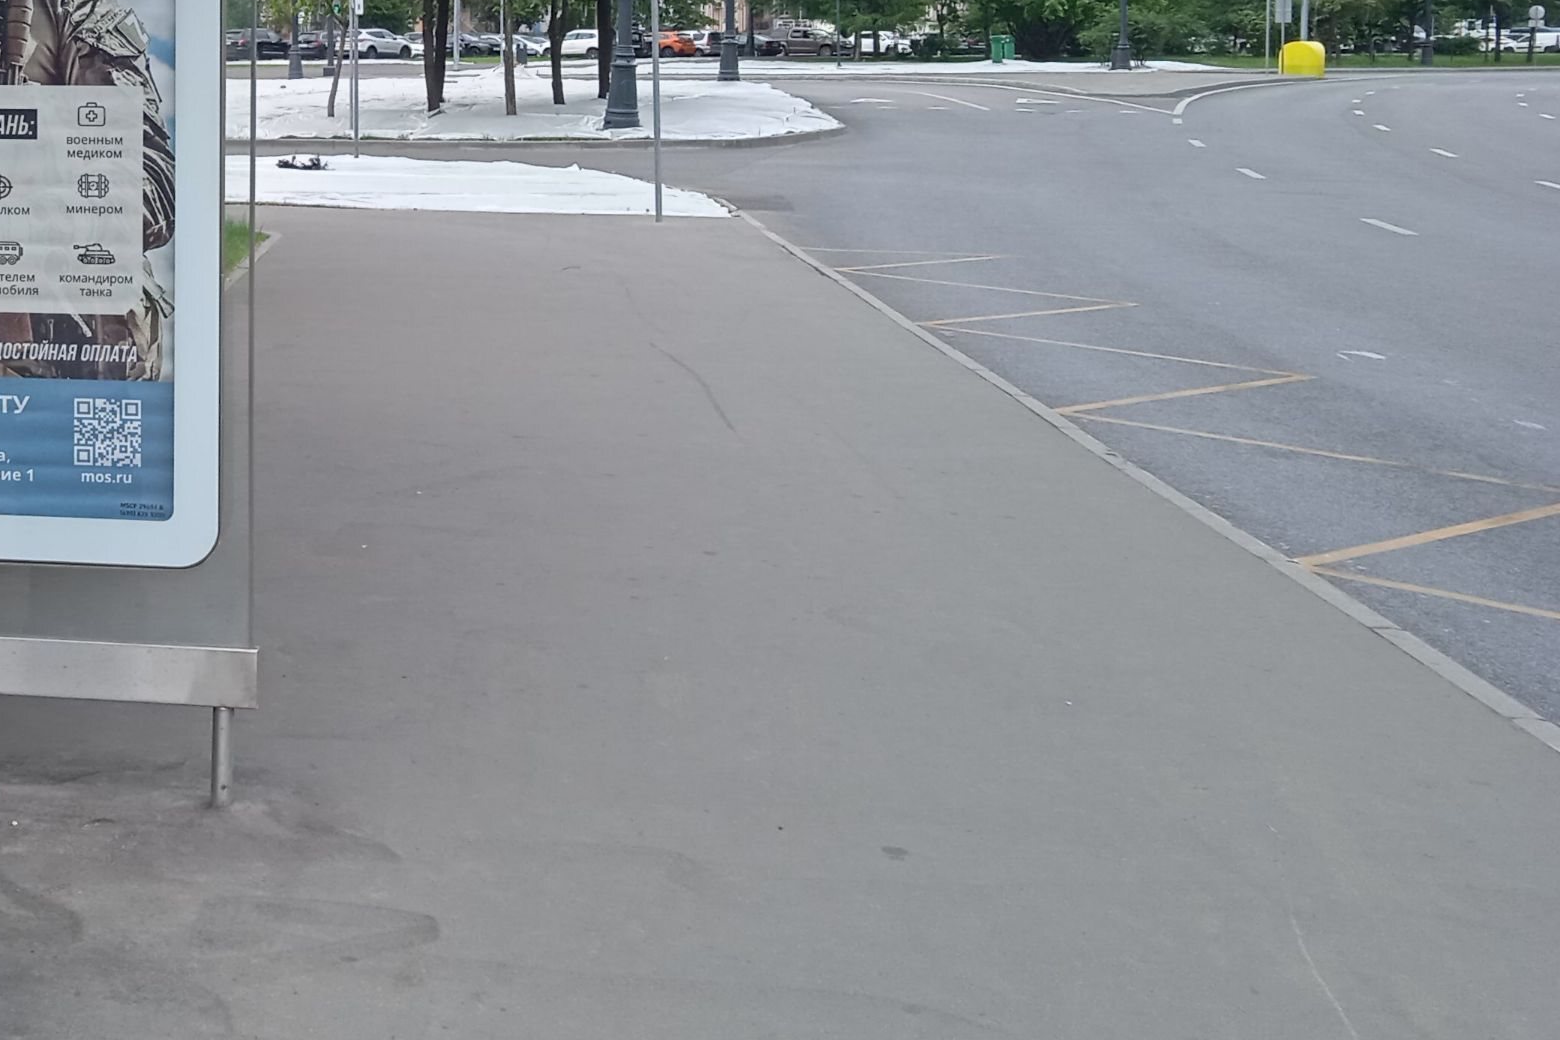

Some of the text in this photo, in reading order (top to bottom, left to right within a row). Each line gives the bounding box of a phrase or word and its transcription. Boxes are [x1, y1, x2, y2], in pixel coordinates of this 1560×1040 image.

[66, 135, 123, 146] военным
[66, 149, 123, 160] медиком
[66, 205, 123, 216] минером
[59, 274, 133, 285] командиром
[79, 287, 112, 297] танка
[80, 343, 138, 362] ОПЛАТА
[26, 469, 34, 482] 1
[81, 471, 132, 484] mos.ru
